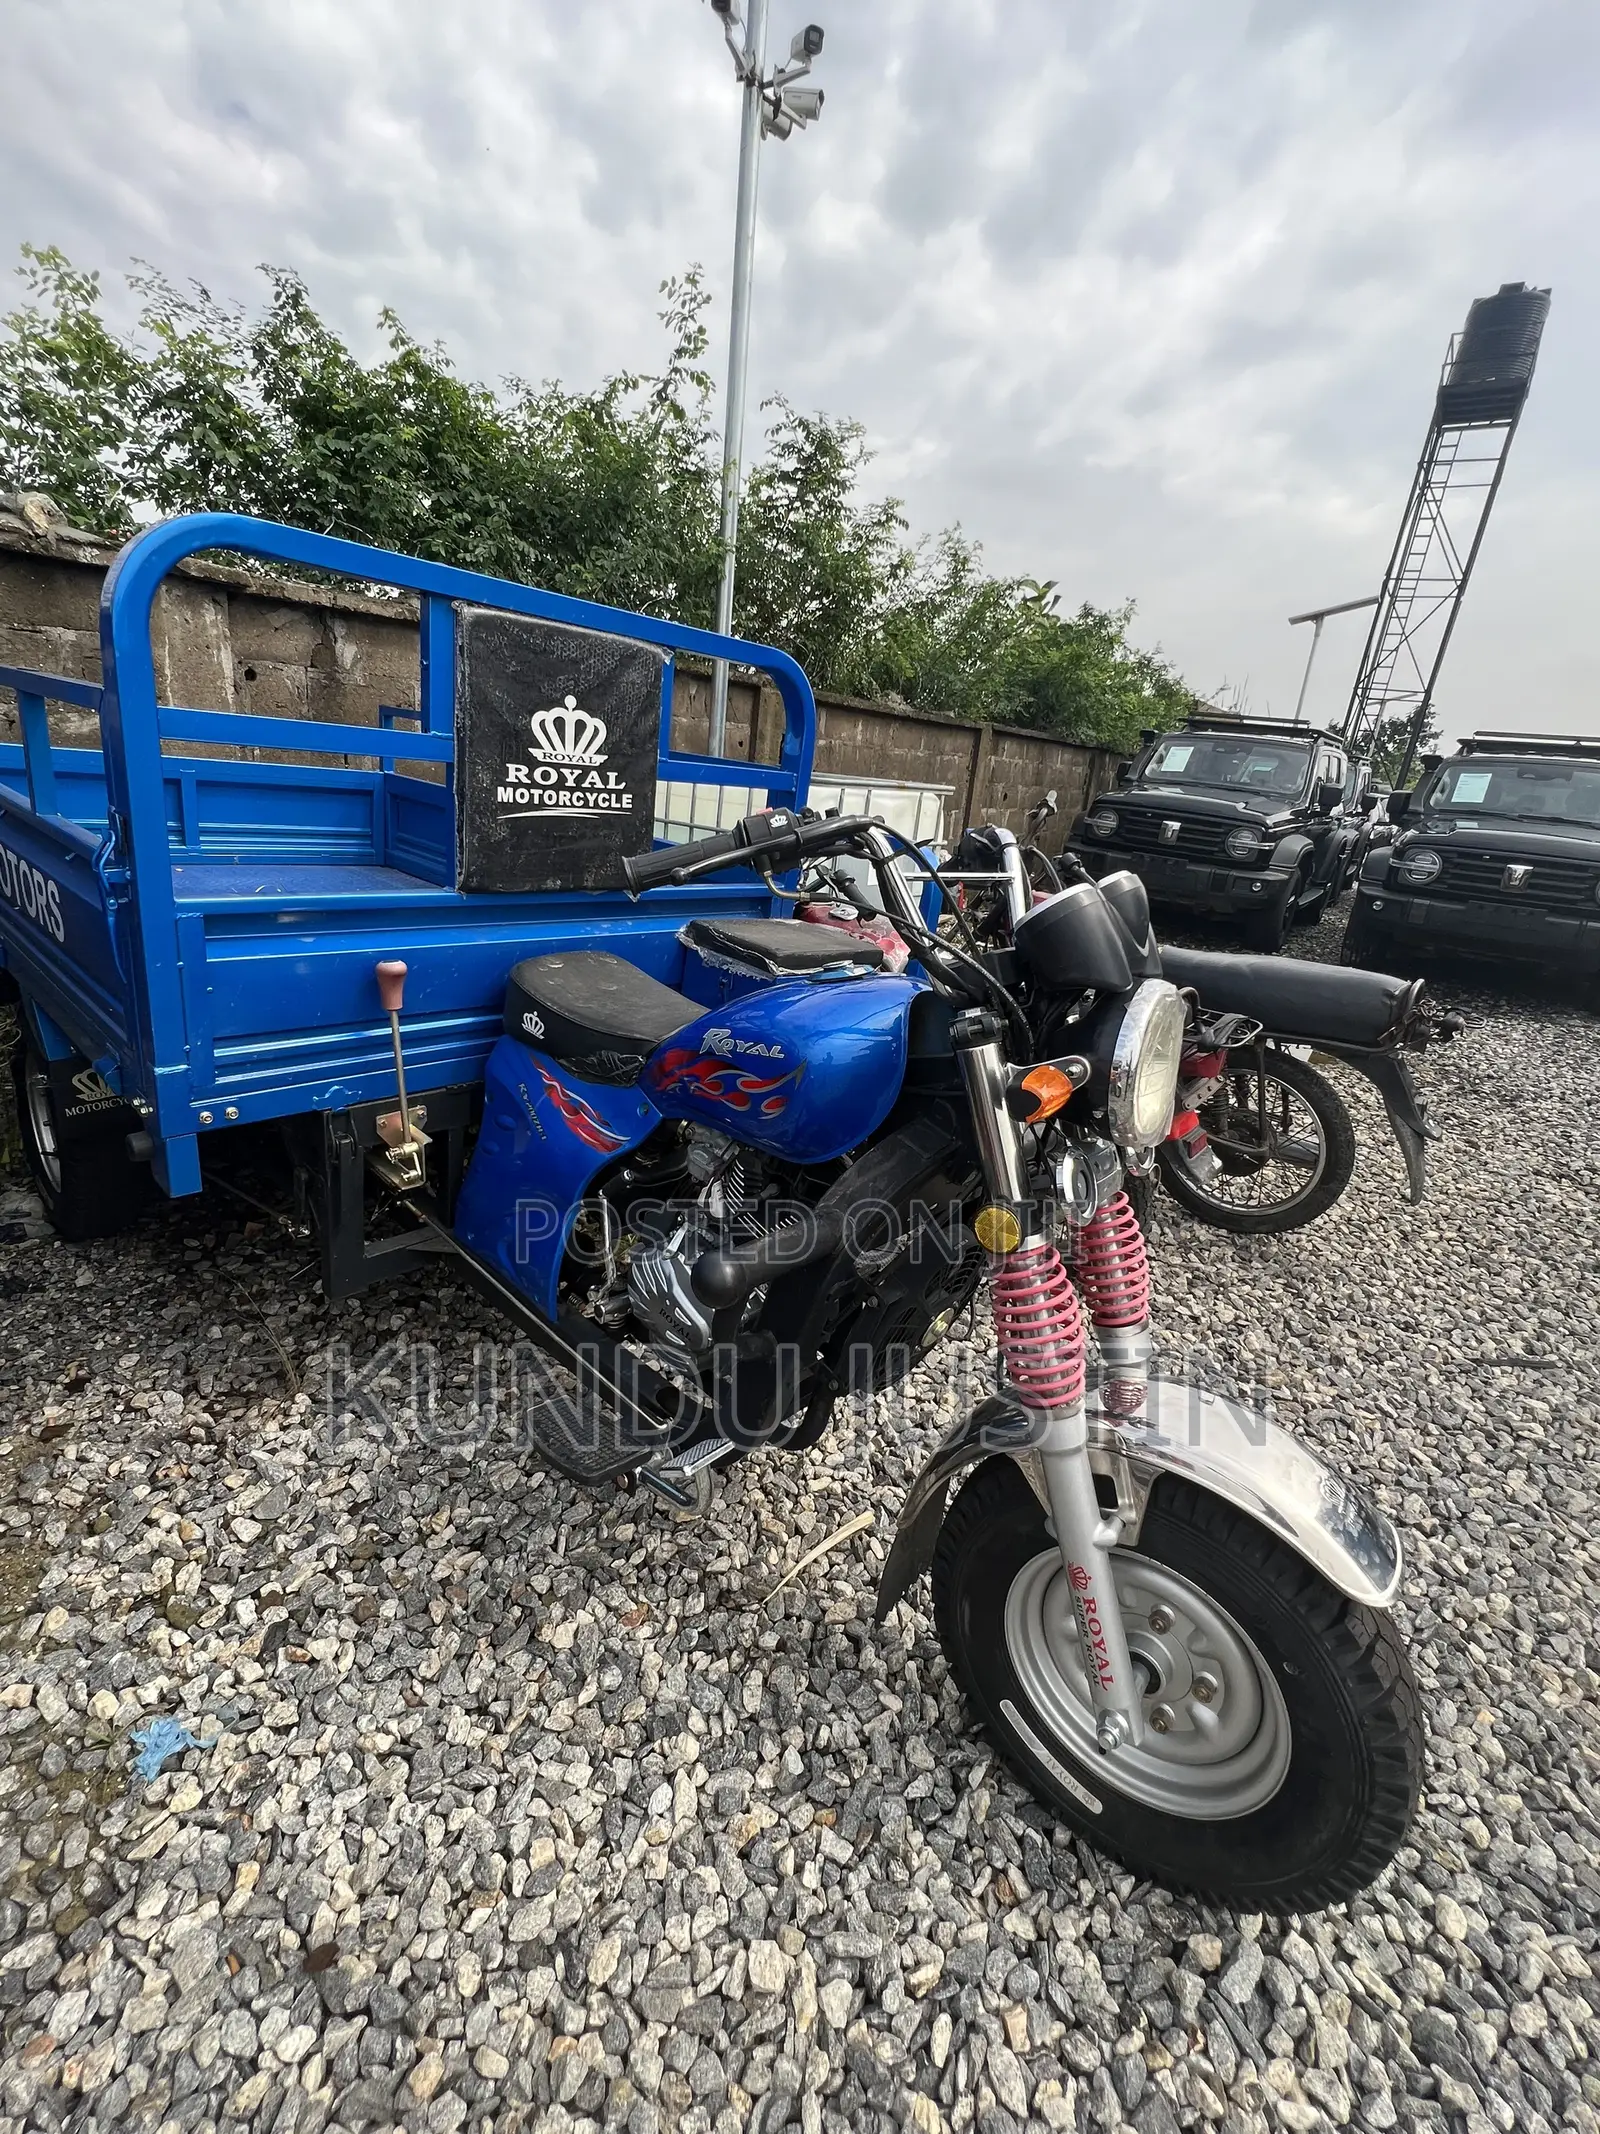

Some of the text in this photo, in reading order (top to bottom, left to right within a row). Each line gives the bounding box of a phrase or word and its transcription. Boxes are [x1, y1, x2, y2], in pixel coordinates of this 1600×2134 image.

[541, 751, 598, 765] ROYAL
[505, 763, 627, 790] ROYAL
[497, 786, 633, 809] MOTORCYCLE
[659, 1308, 692, 1341] ROYAL
[1075, 1595, 1101, 1688] SUPER ROYAL
[1082, 1596, 1114, 1692] ROYAL
[1045, 1755, 1079, 1792] ROYAL
